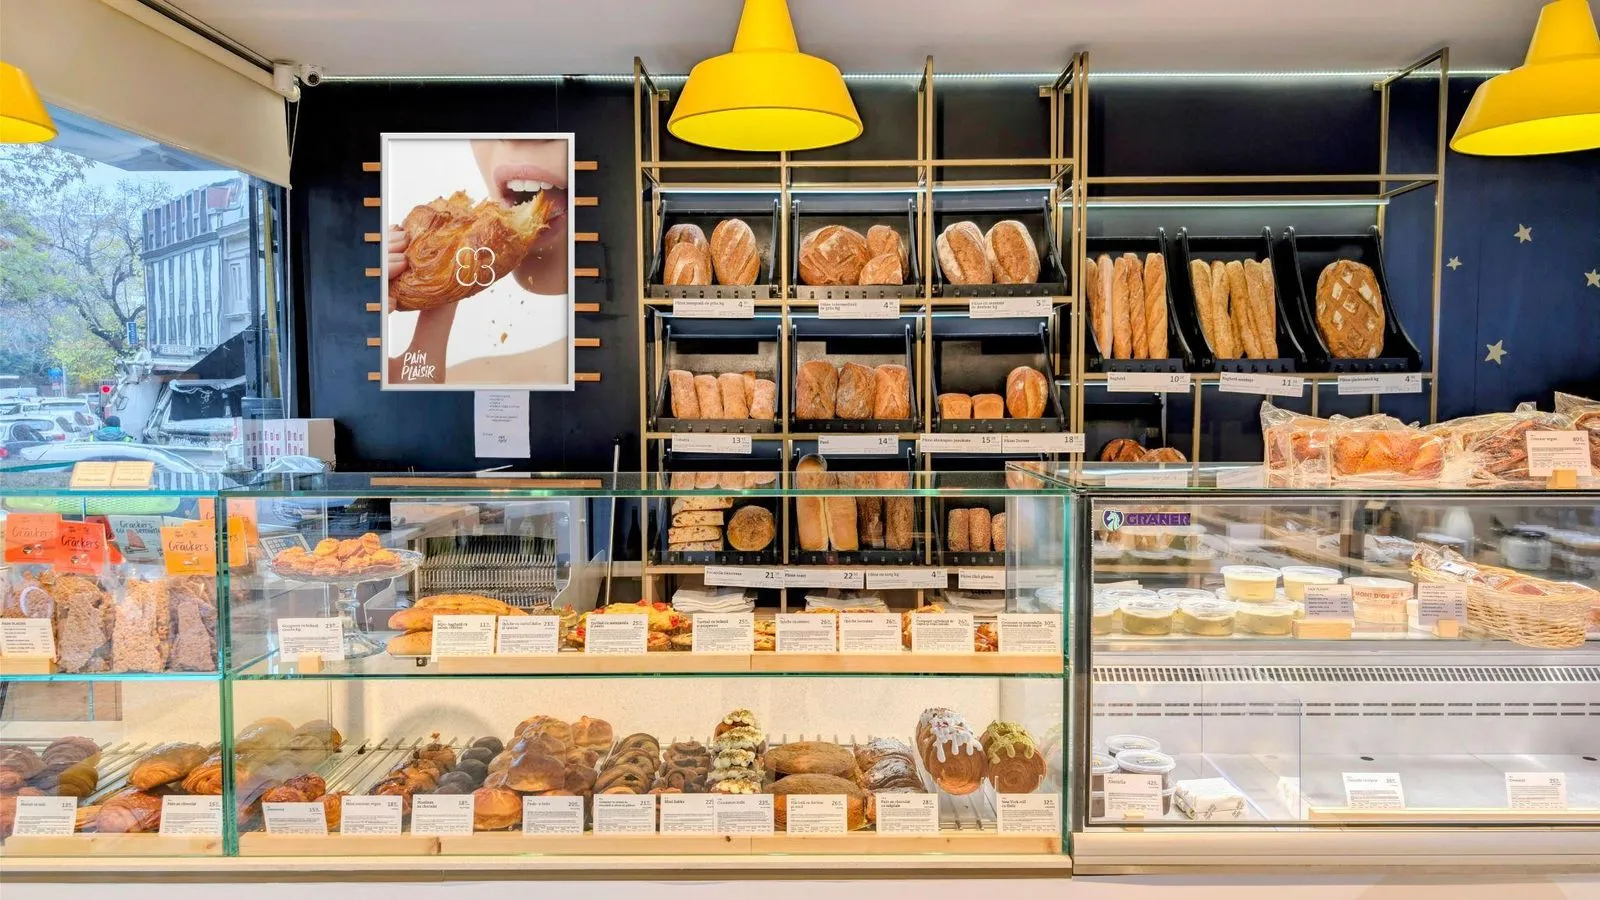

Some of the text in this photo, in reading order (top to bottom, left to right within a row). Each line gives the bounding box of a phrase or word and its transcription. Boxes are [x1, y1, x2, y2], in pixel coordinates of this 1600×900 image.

[1126, 513, 1190, 526] GRANER
[61, 535, 100, 549] Crackers
[168, 541, 210, 552] Crackers
